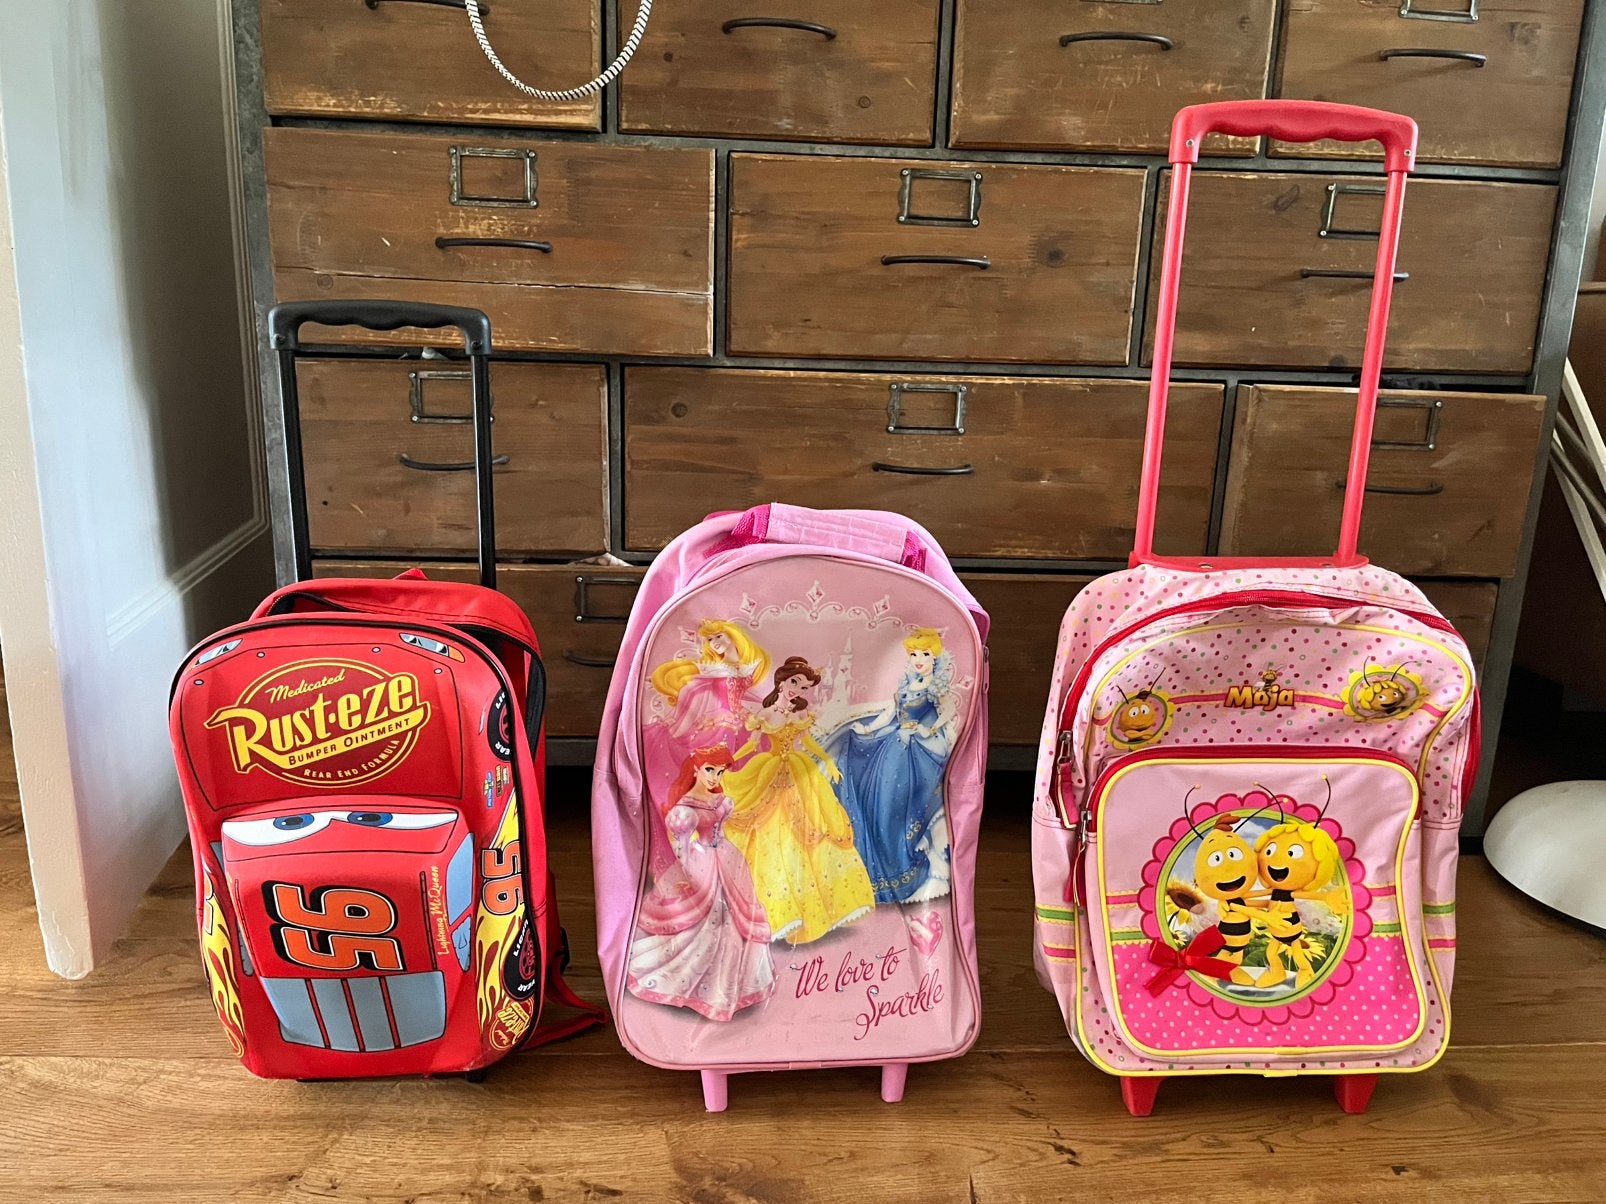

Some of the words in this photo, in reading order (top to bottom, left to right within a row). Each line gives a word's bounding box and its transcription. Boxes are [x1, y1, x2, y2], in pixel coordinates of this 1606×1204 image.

[265, 668, 346, 704] Medicated
[1224, 684, 1295, 712] Maja
[288, 743, 337, 766] BUMPER
[343, 717, 411, 748] OINTMENT
[303, 768, 332, 779] REAR
[337, 767, 359, 778] END
[361, 740, 400, 771] FORMULA
[427, 865, 443, 916] McQueen
[481, 839, 524, 915] 95
[266, 880, 406, 971] 95
[435, 917, 451, 956] Lightning
[791, 956, 829, 999] We
[835, 951, 874, 992] love
[875, 946, 907, 981] to
[854, 968, 945, 1041] Sparkle
